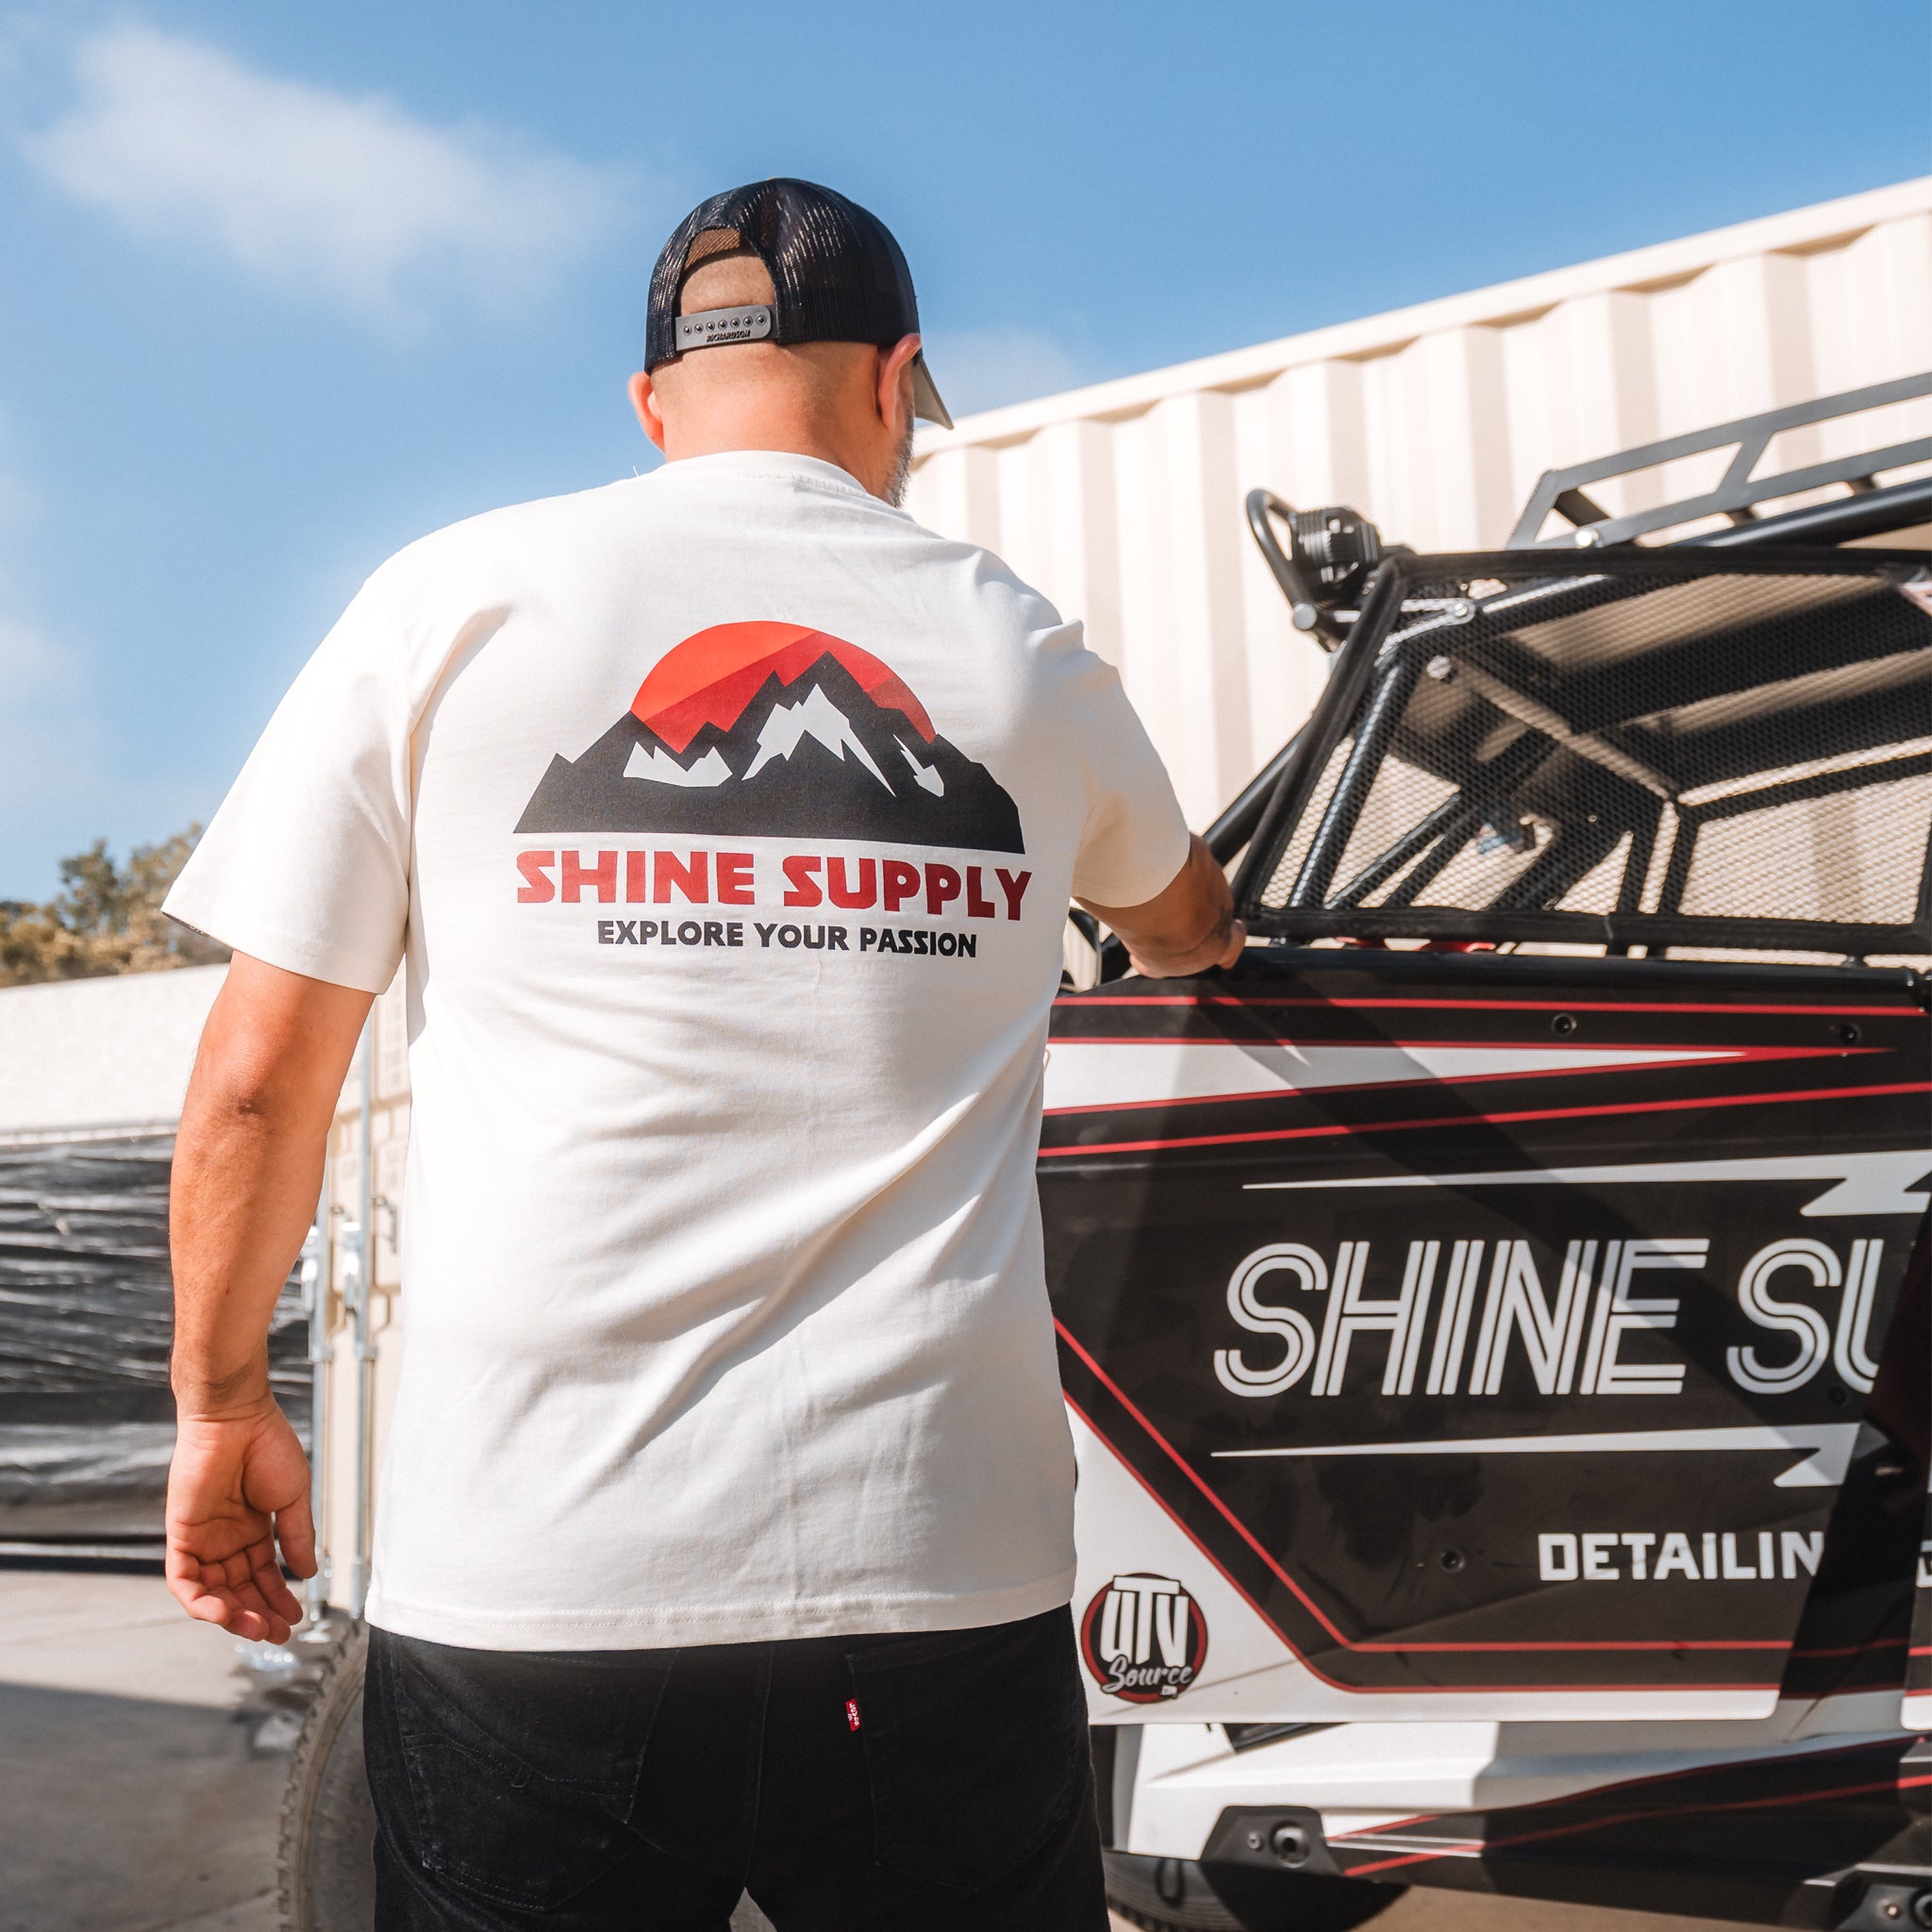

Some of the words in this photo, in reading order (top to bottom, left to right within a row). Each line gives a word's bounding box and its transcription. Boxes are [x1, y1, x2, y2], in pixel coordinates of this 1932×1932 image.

[517, 850, 756, 906] SHINE
[782, 855, 1032, 921] SUPPLY
[597, 920, 743, 947] EXPLORE
[754, 923, 850, 951] YOUR
[859, 926, 977, 958] PASSION
[1213, 1239, 1710, 1398] SHINE
[1100, 1575, 1189, 1667] UTV
[1101, 1657, 1192, 1692] Source
